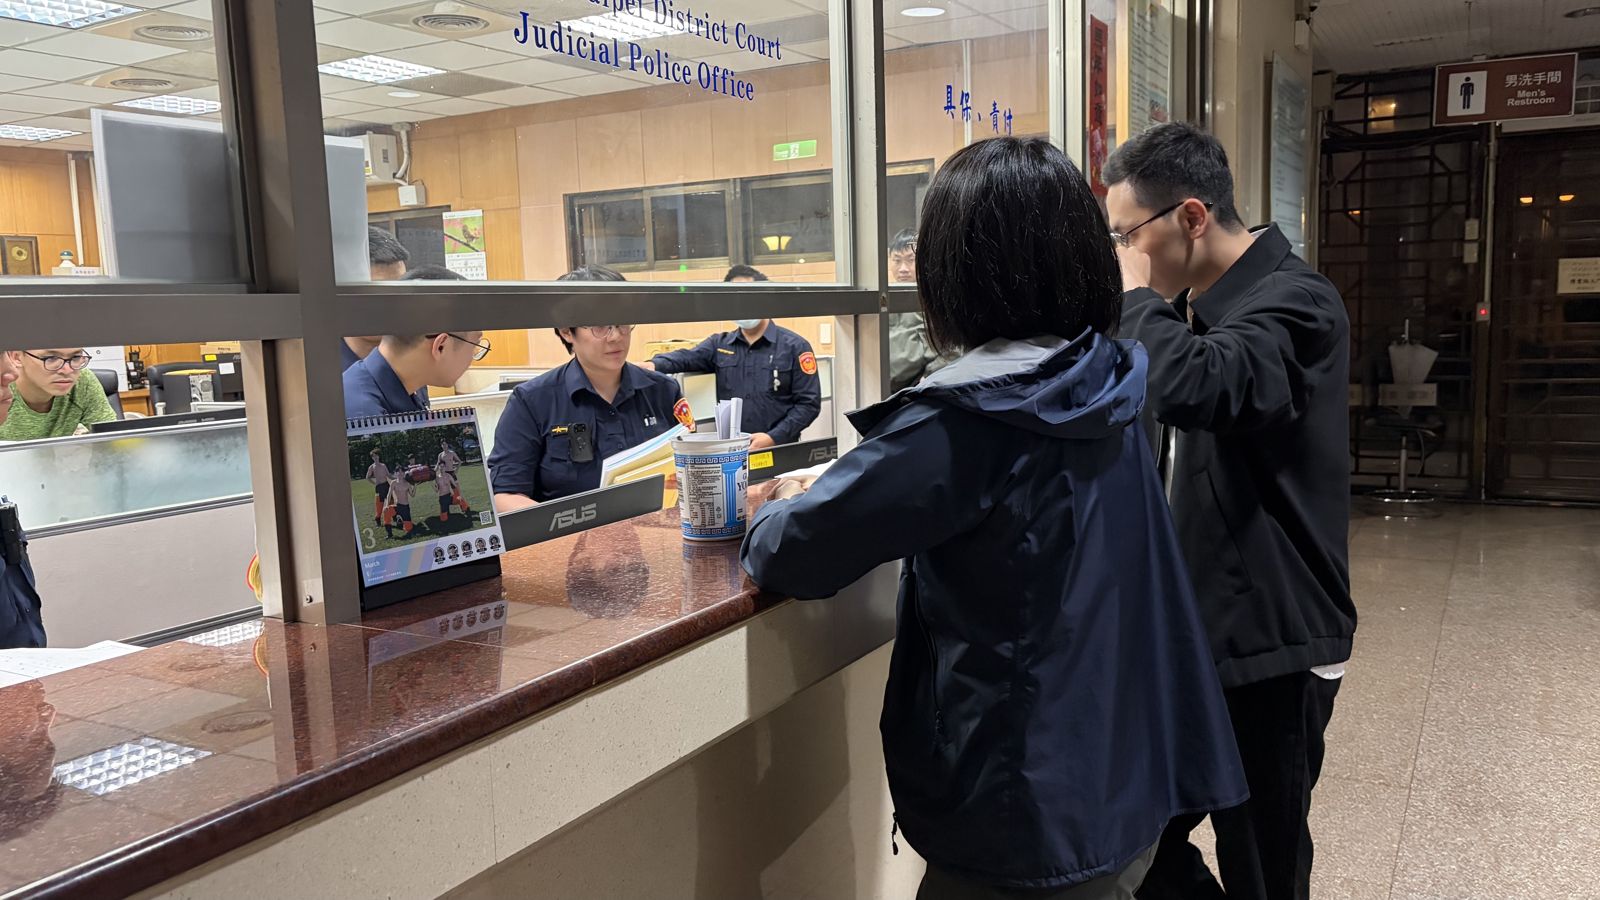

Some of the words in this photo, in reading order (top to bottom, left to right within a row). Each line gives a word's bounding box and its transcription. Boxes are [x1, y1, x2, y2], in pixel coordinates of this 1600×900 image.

[653, 0, 729, 45] District
[736, 23, 782, 60] Court
[514, 11, 620, 68] Judicial
[628, 41, 692, 86] Police
[699, 62, 755, 101] Office
[1504, 71, 1562, 87] 男洗手間
[1507, 96, 1555, 107] Restroom
[1517, 89, 1546, 98] Men's
[549, 502, 597, 532] ASUS
[362, 527, 376, 550] 3
